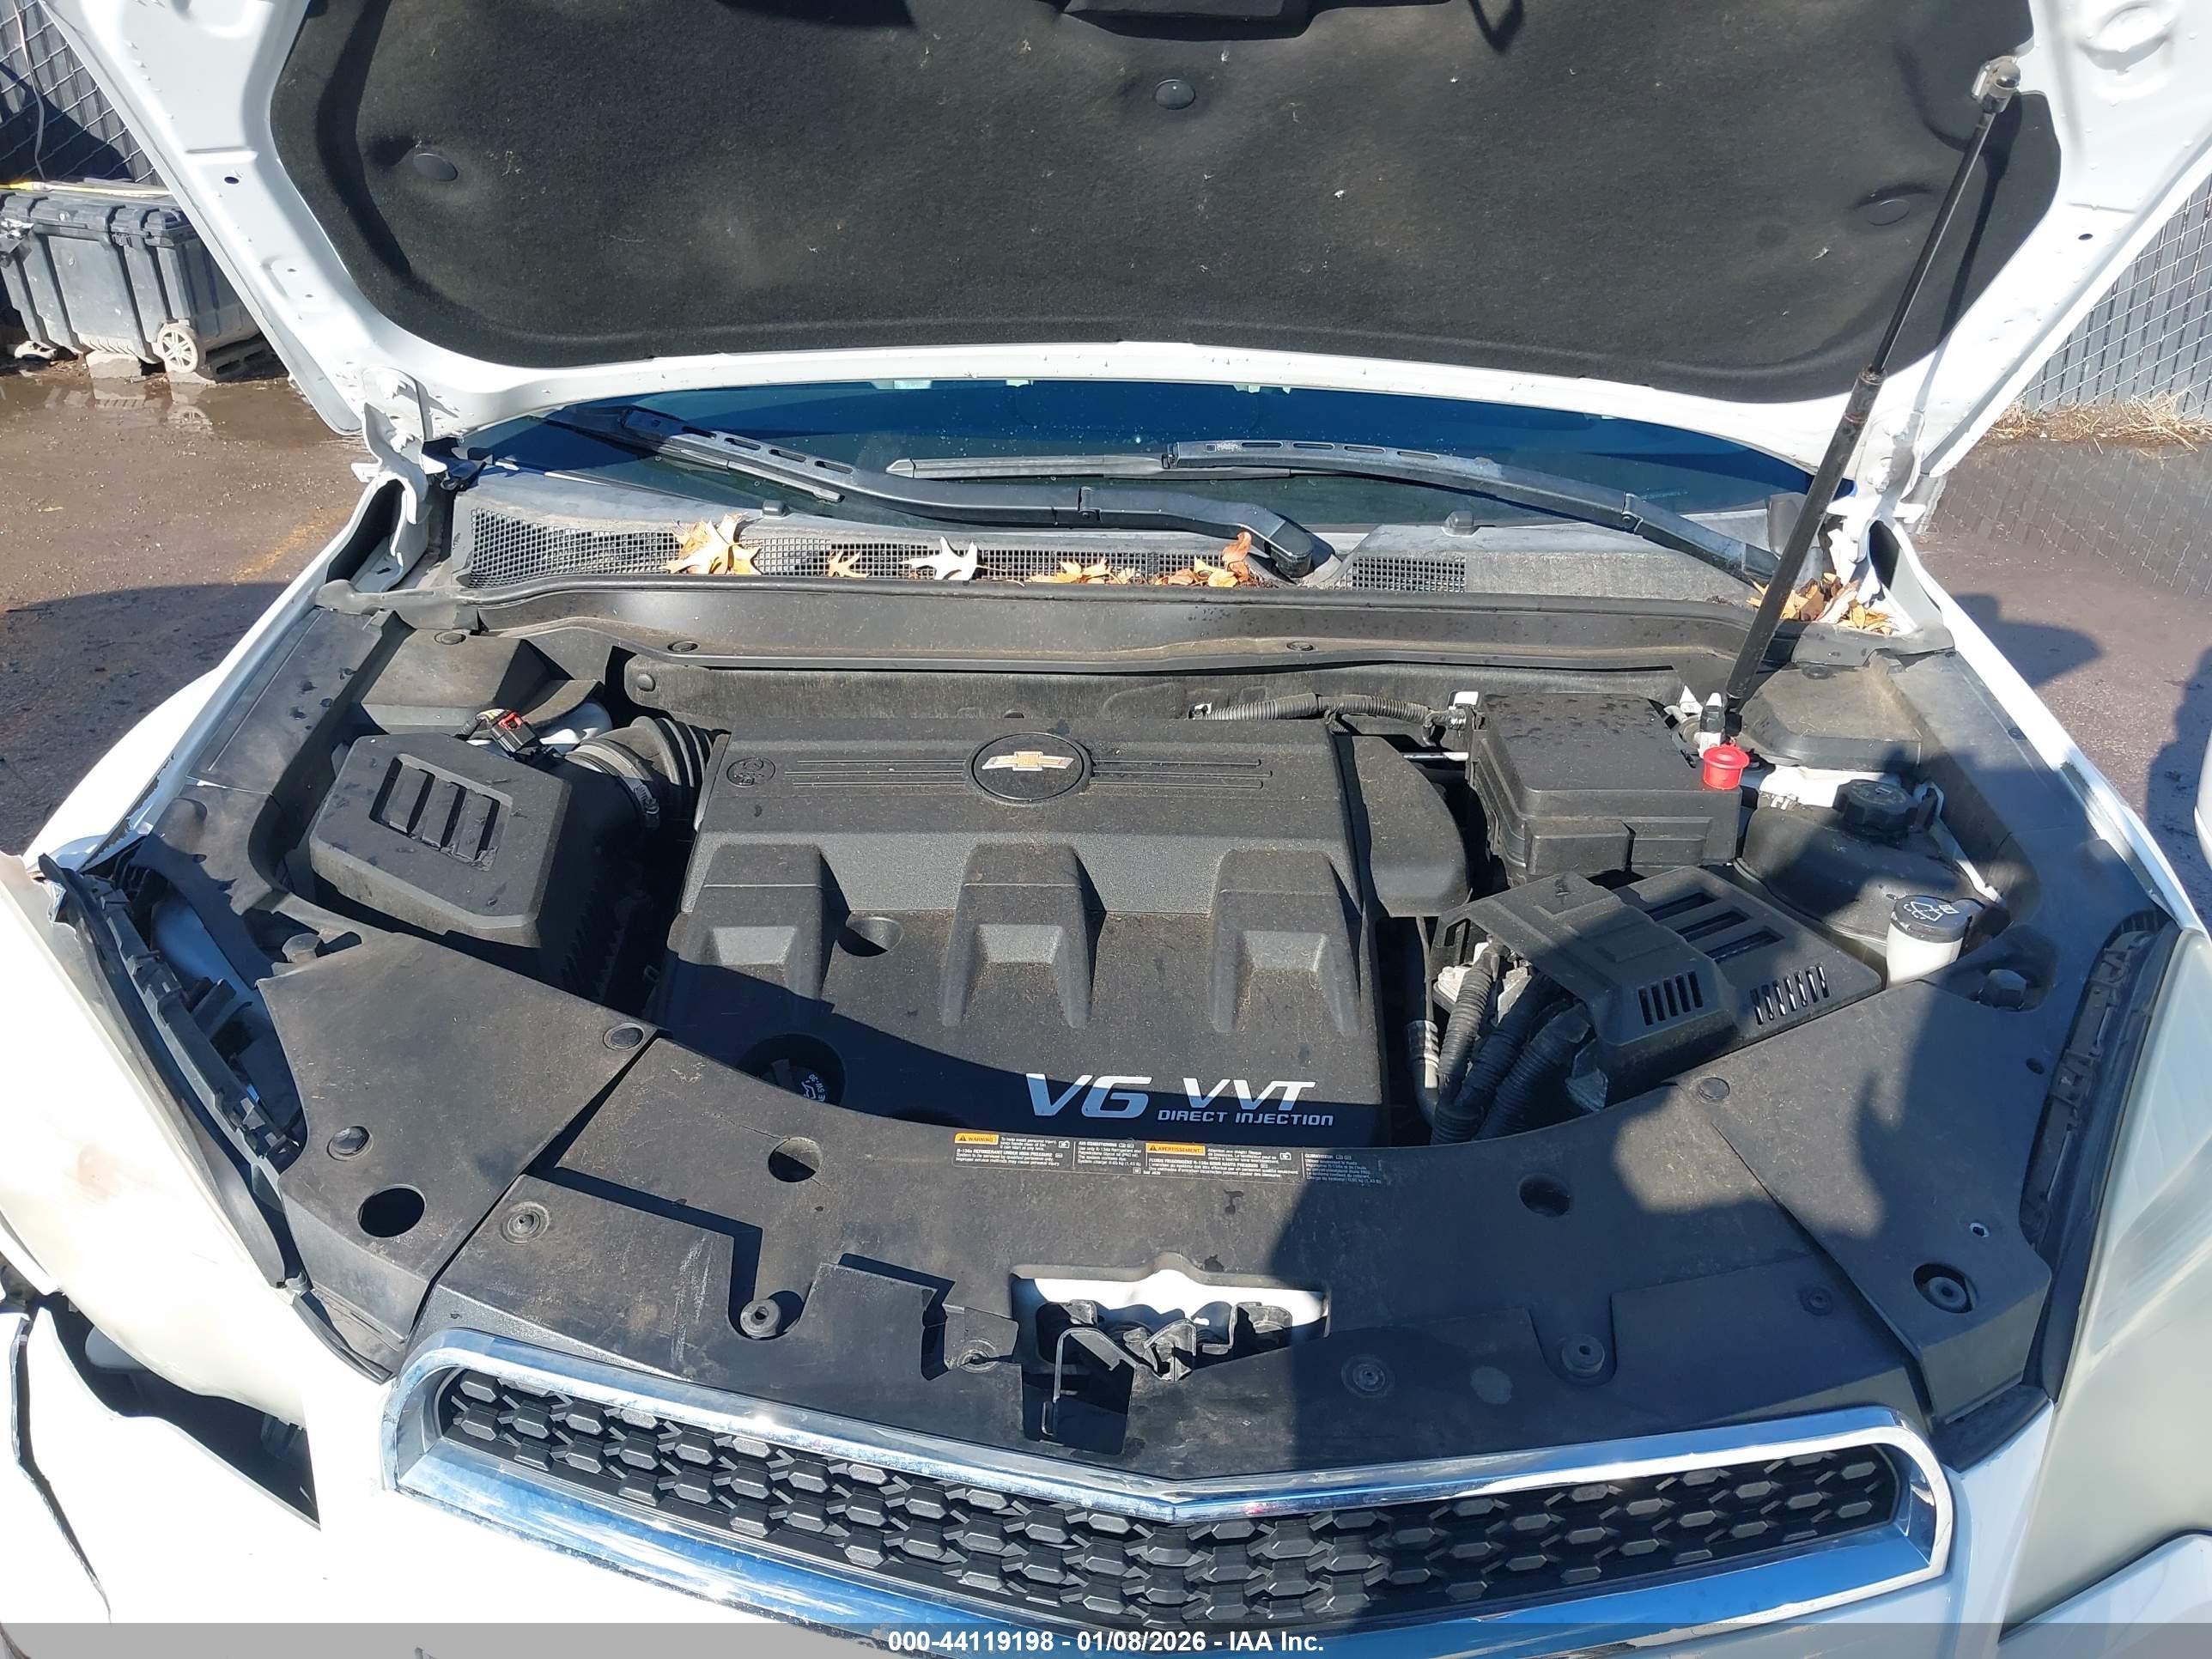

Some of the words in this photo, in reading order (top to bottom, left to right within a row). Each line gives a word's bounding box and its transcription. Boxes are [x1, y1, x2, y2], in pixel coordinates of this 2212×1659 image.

[1026, 1073, 1152, 1118] V6
[1183, 1078, 1316, 1111] VVT
[1158, 1109, 1227, 1123] DIRECT
[1235, 1112, 1334, 1127] INJECTION
